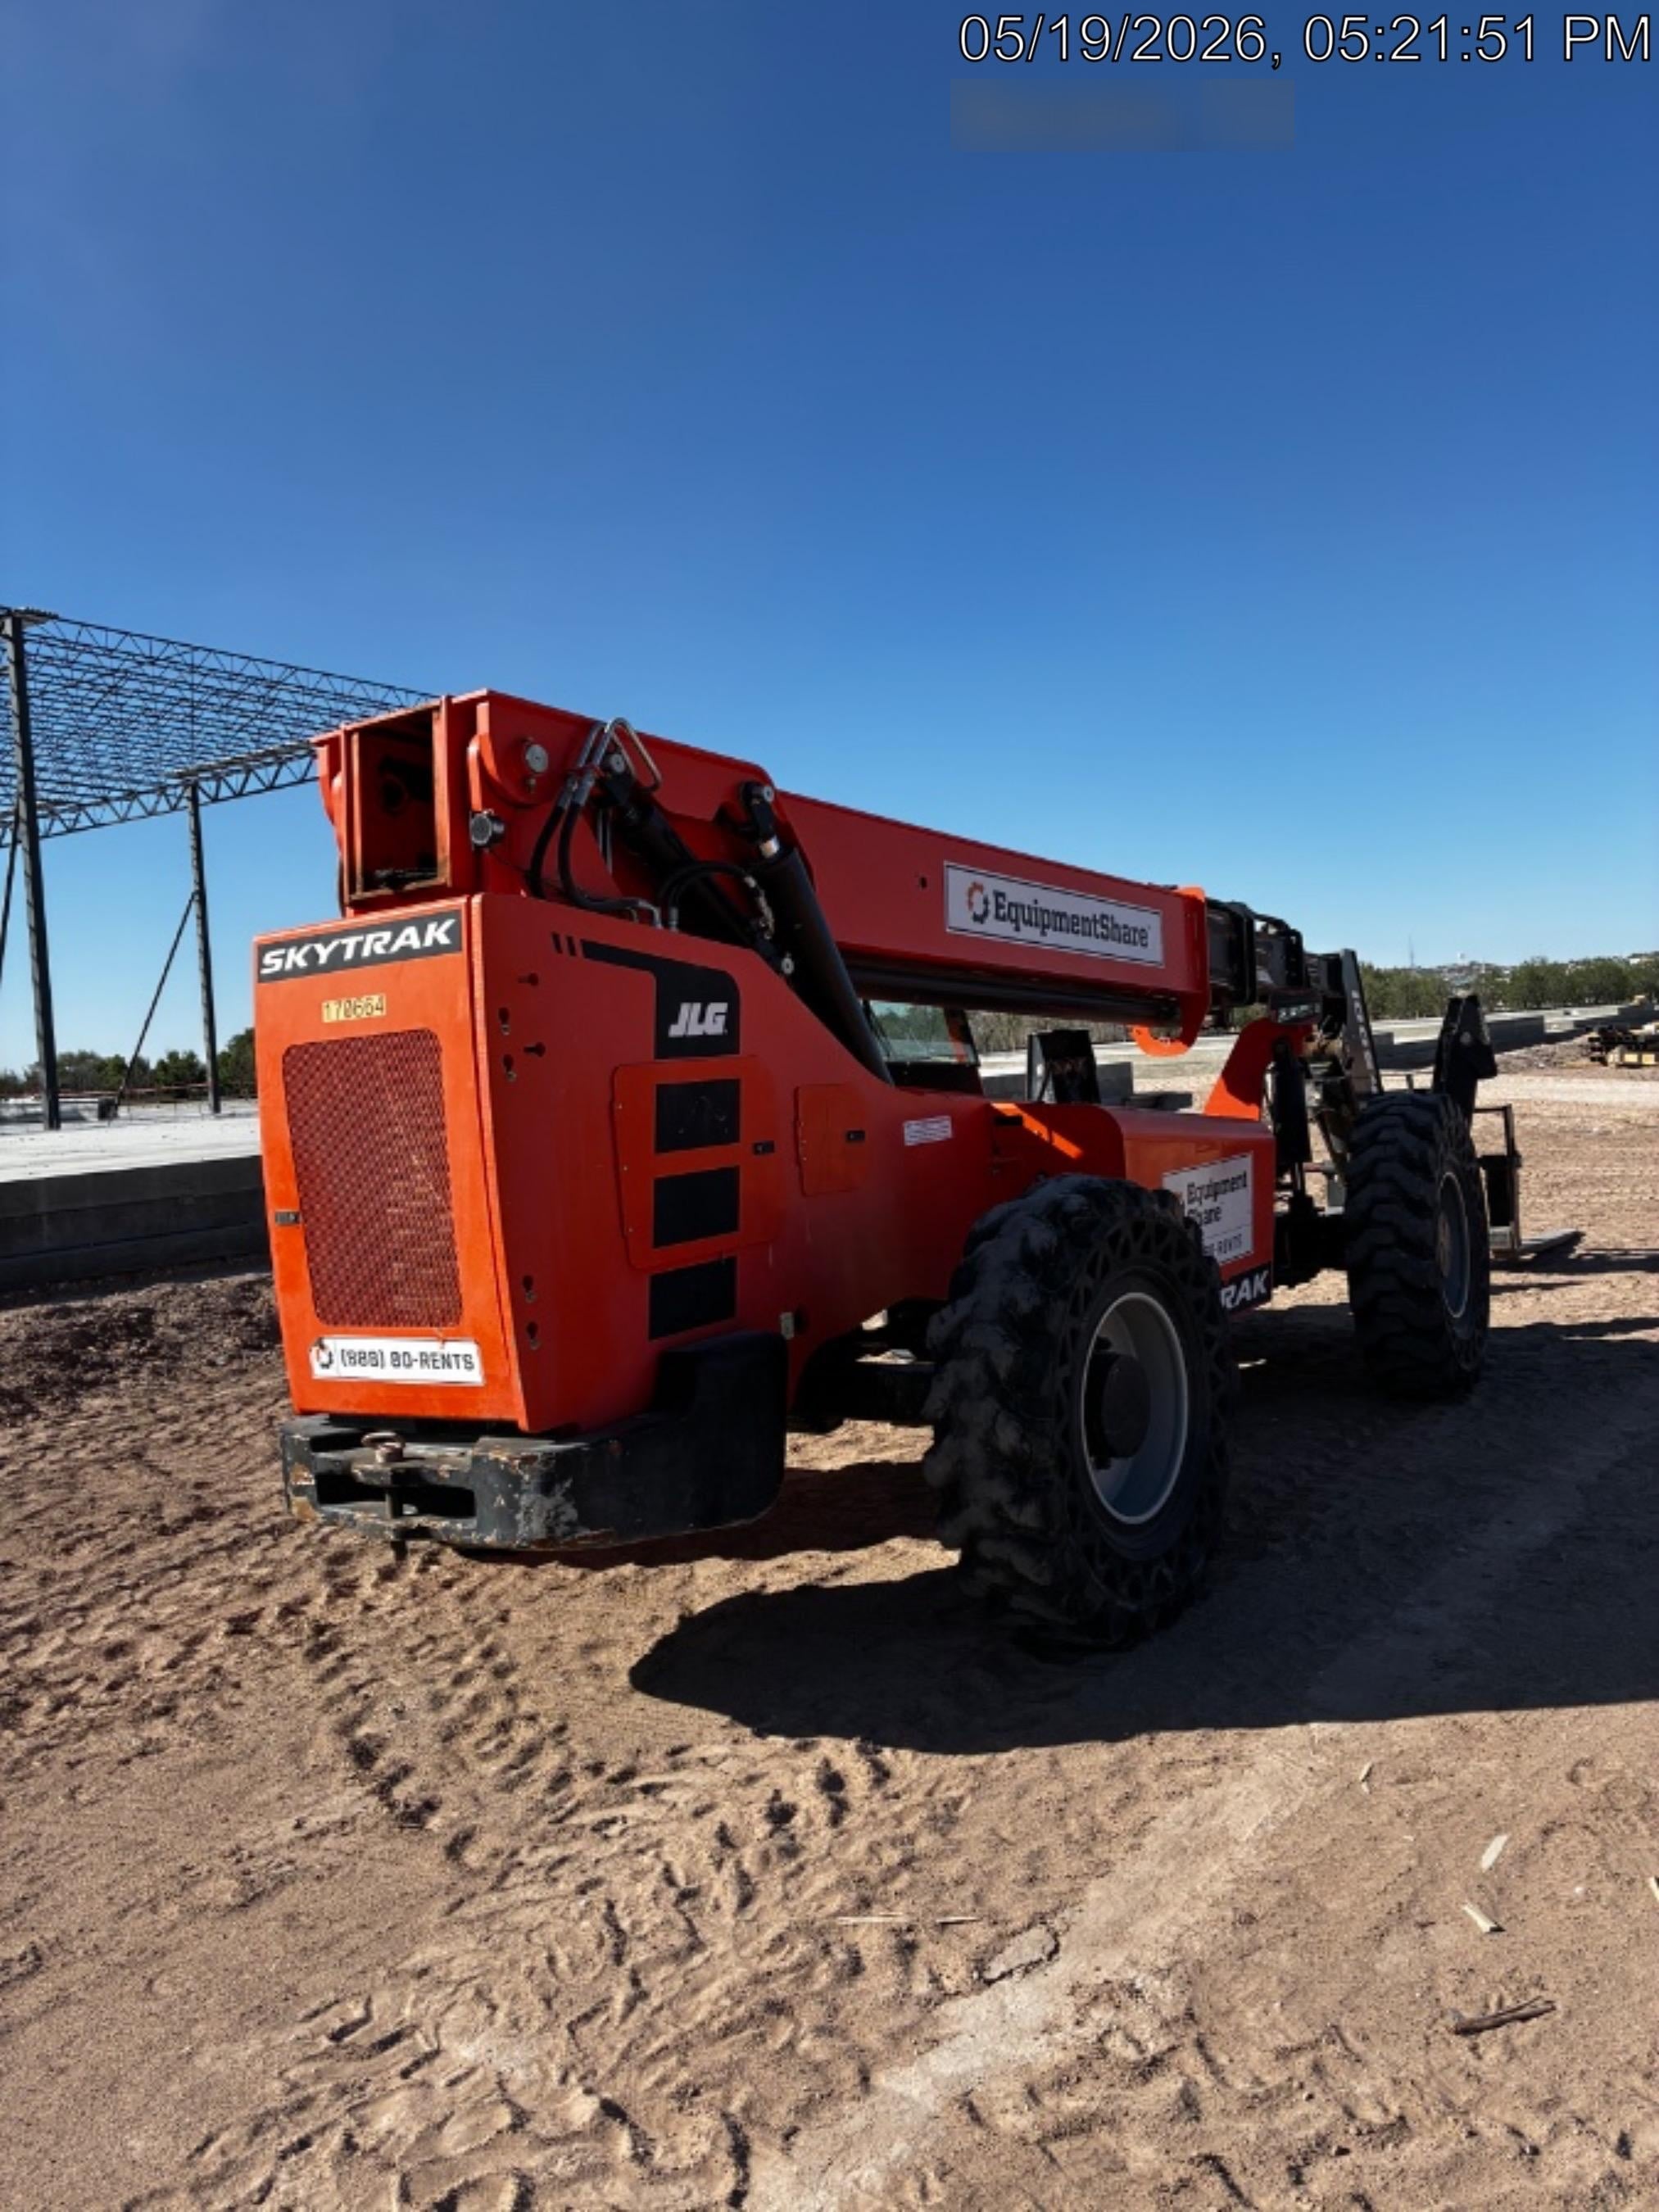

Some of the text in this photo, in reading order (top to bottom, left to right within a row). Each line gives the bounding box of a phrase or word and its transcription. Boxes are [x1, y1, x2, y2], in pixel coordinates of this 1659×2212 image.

[260, 918, 456, 975] SKYTRAK
[993, 889, 1149, 948] EquipmentShare
[668, 1002, 728, 1038] JLG
